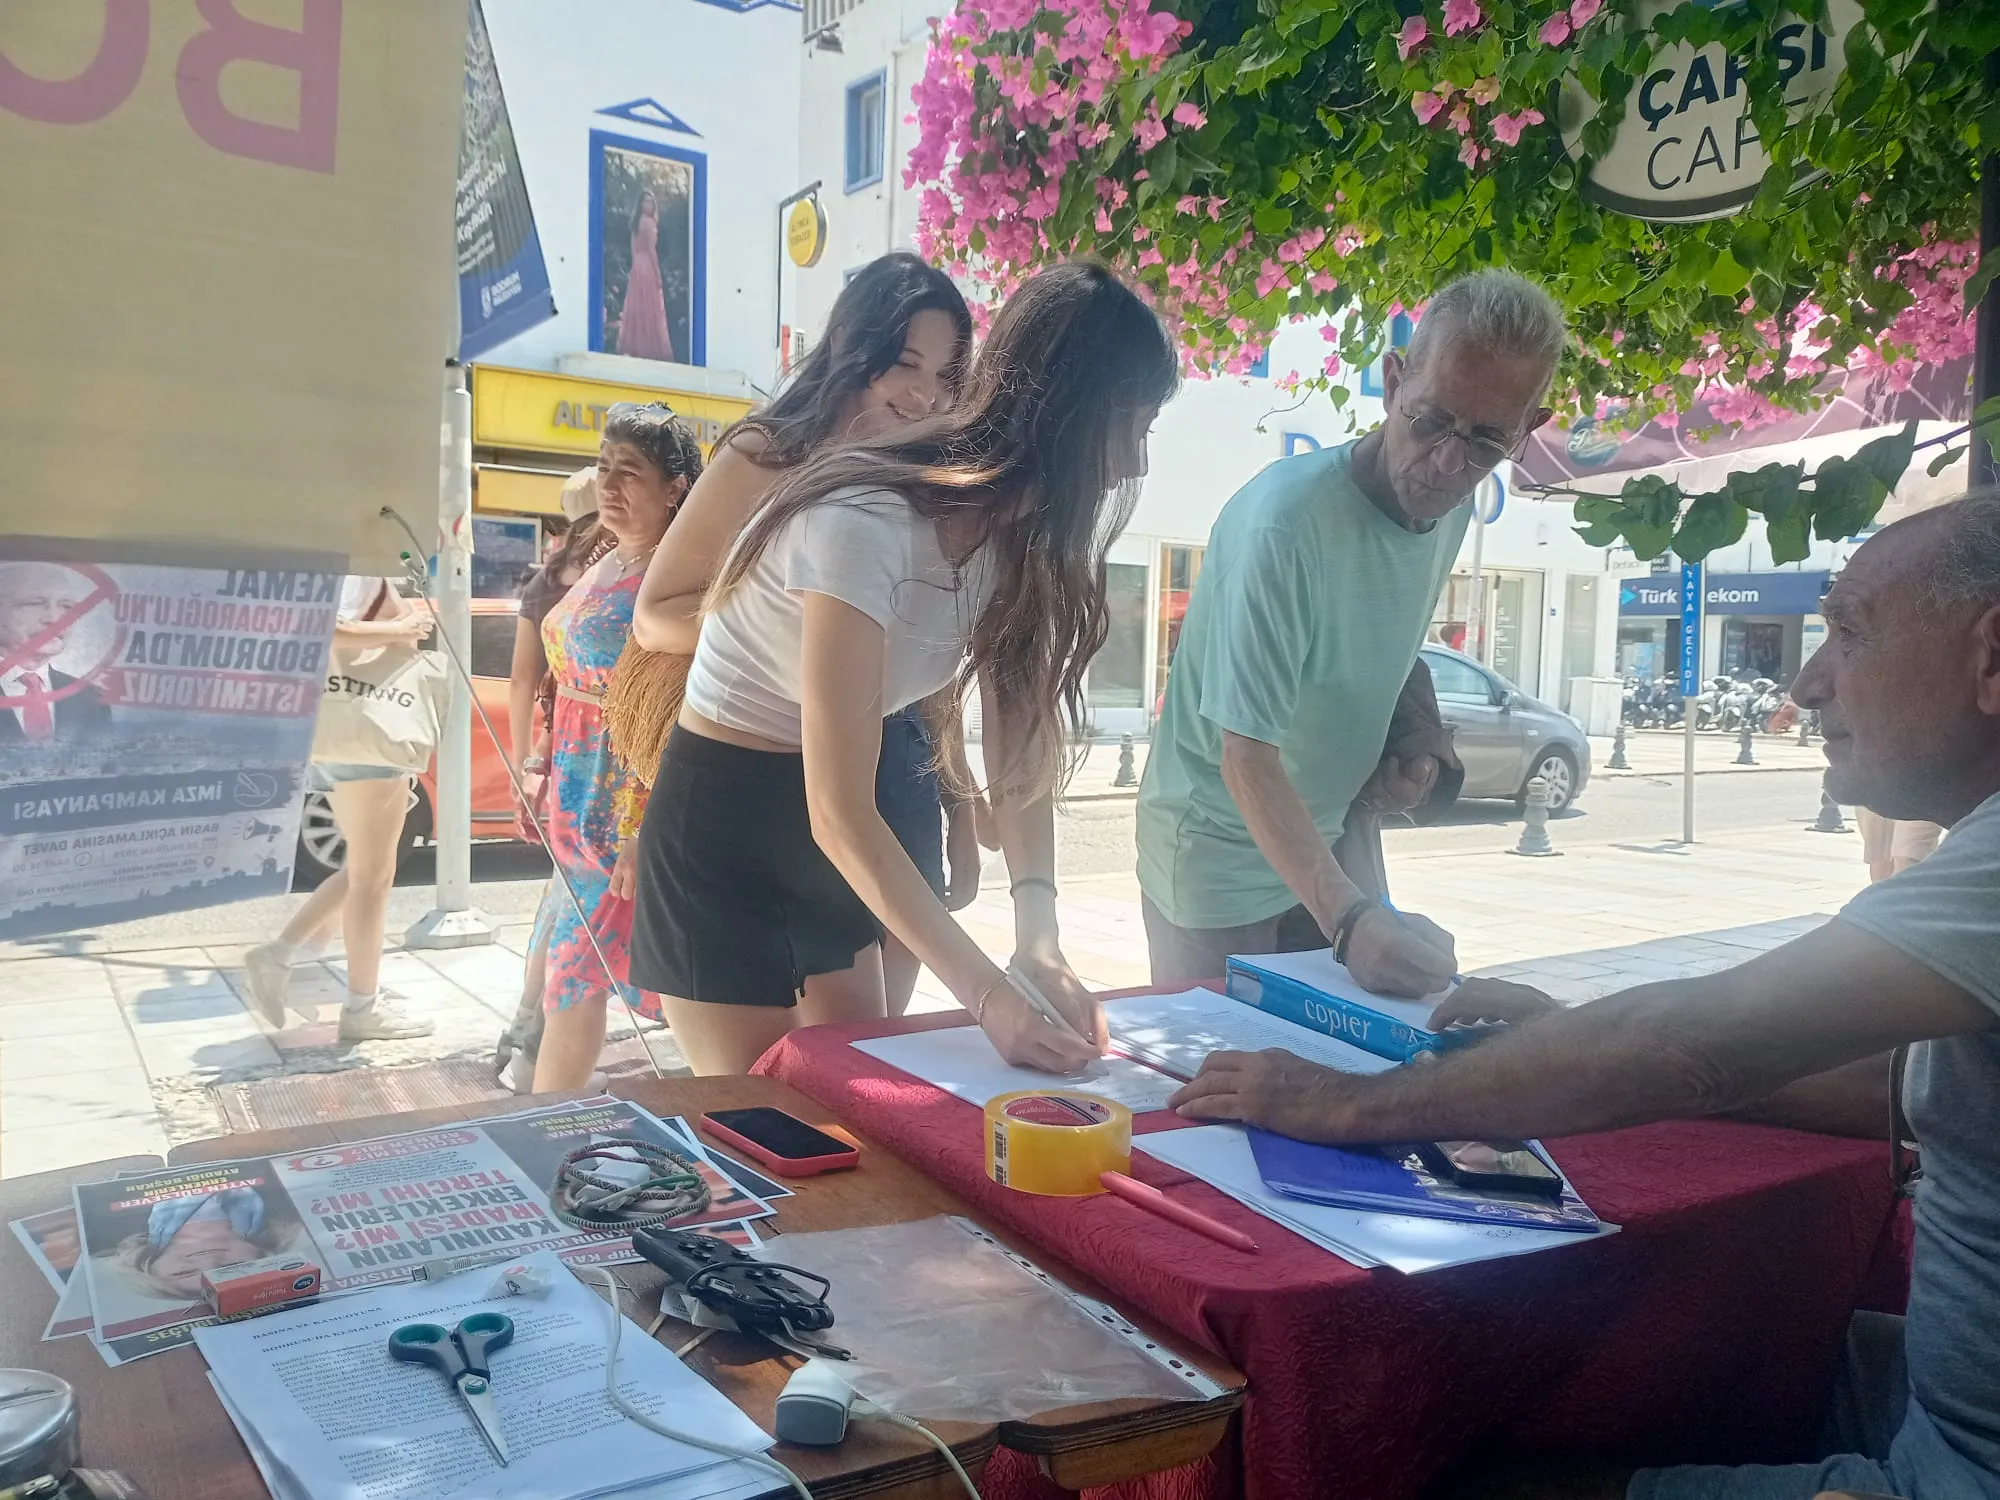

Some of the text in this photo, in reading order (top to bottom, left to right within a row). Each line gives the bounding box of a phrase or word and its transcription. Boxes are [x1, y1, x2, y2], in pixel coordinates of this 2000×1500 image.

[1648, 98, 1808, 190] CAF
[554, 400, 602, 432] ALT
[1639, 588, 1760, 605] Türk ekom
[1685, 570, 1695, 612] YAYA
[1304, 999, 1372, 1040] copier
[547, 1128, 587, 1139] KAYA
[207, 1178, 258, 1194] AYTEN
[320, 1184, 529, 1232] ERKEKLERİN
[404, 1200, 546, 1240] İRADESİ
[346, 1217, 562, 1269] KADINLARIN
